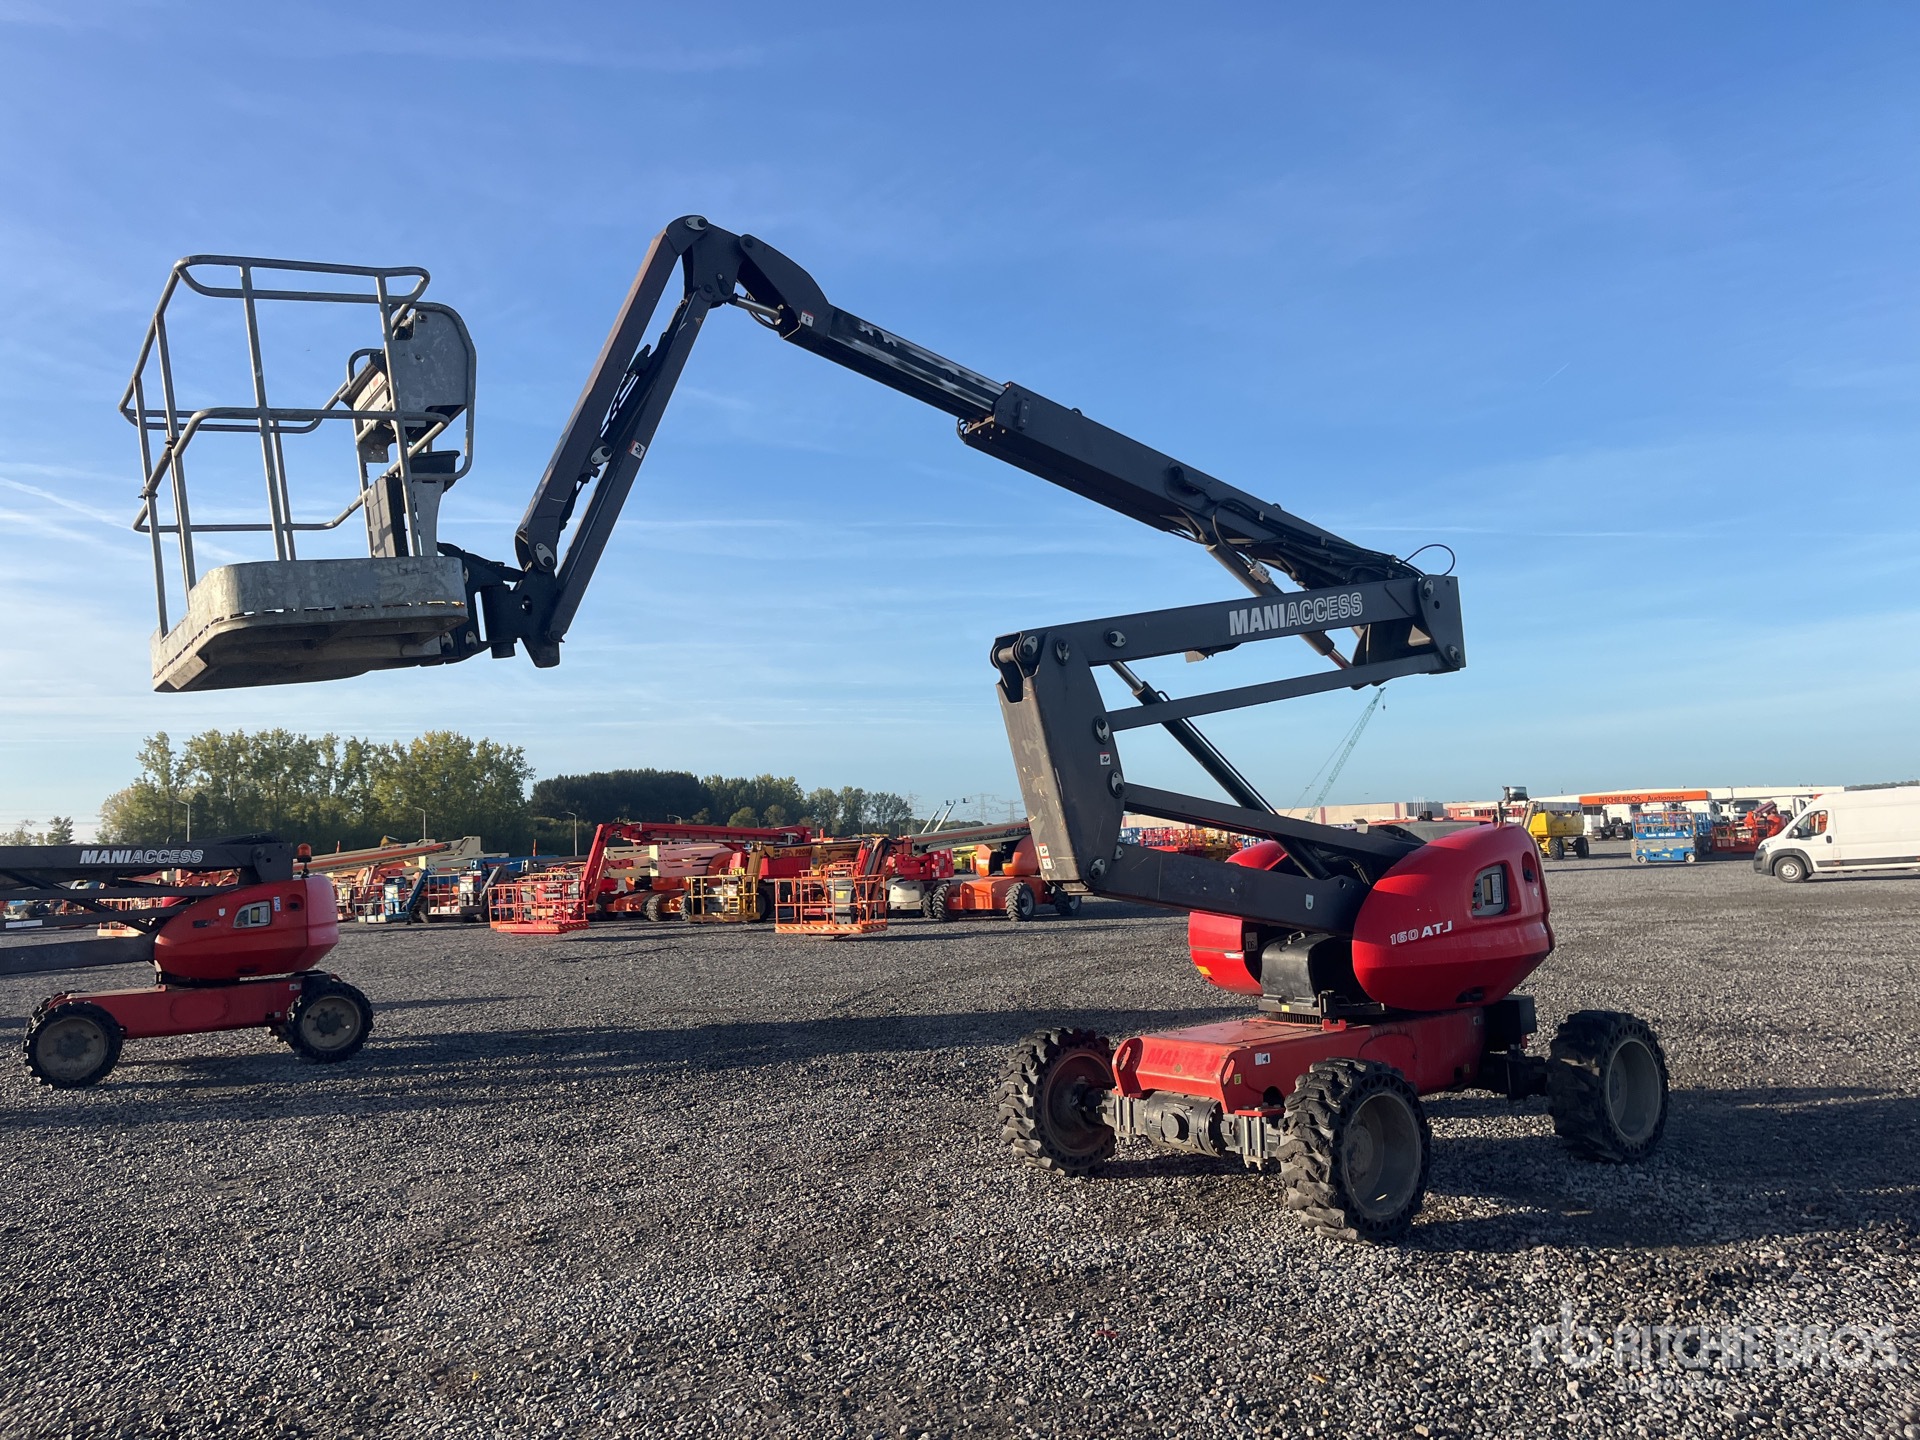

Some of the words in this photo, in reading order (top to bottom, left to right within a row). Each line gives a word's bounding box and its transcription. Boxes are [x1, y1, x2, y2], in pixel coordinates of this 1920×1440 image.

[1229, 592, 1363, 636] MANIACCESS
[1598, 796, 1621, 804] RITCHIE
[1647, 794, 1685, 802] Auctioneers
[80, 850, 204, 864] MANIACCESS
[1390, 928, 1419, 945] 160
[1421, 920, 1453, 938] ATJ
